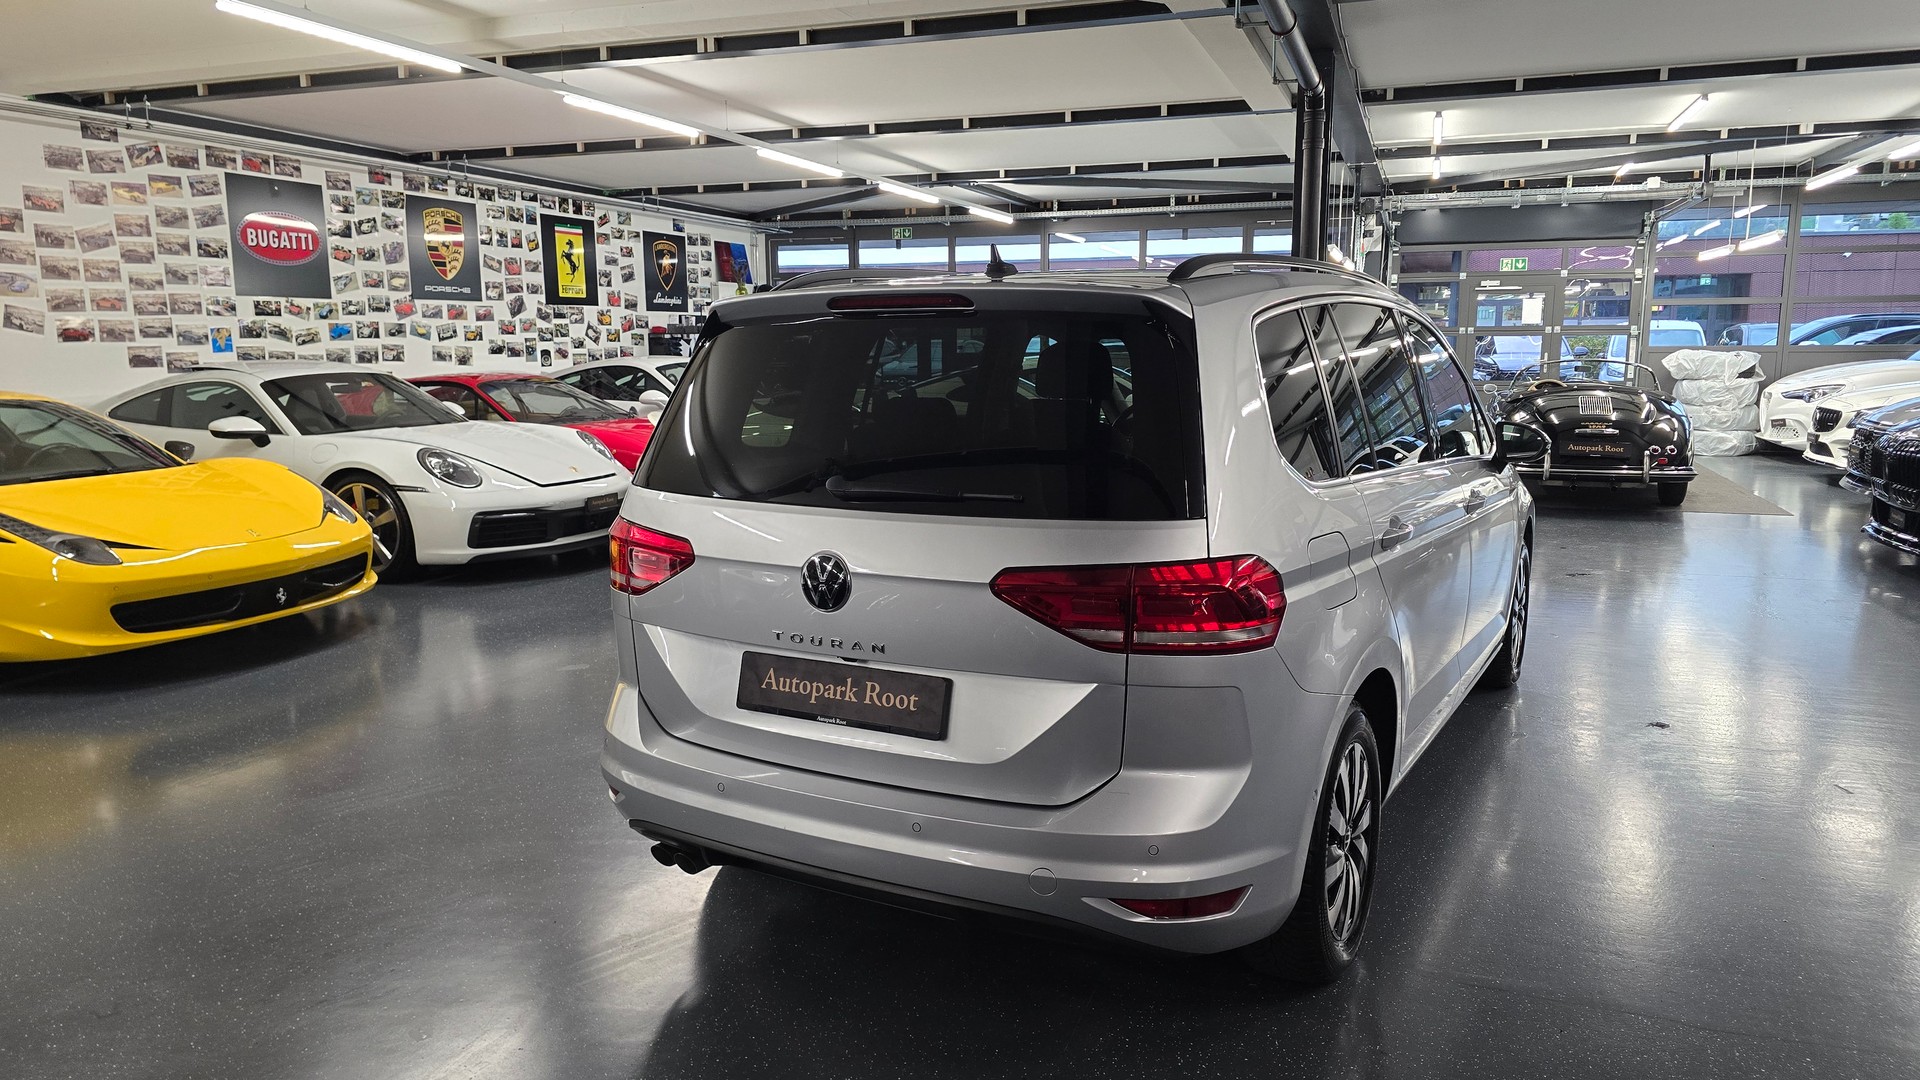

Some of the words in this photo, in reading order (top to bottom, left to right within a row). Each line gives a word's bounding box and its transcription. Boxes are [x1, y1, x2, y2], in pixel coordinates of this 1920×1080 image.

[424, 209, 462, 222] PORSCHE
[246, 228, 314, 251] BUGATTI
[424, 284, 472, 294] PORSCHE
[561, 284, 584, 296] Ferrari
[1568, 443, 1604, 453] Autopark
[1605, 444, 1624, 453] Root
[772, 629, 886, 655] TOURAN
[761, 667, 859, 704] Autopark
[864, 681, 919, 711] Root
[816, 715, 836, 724] Autopark
